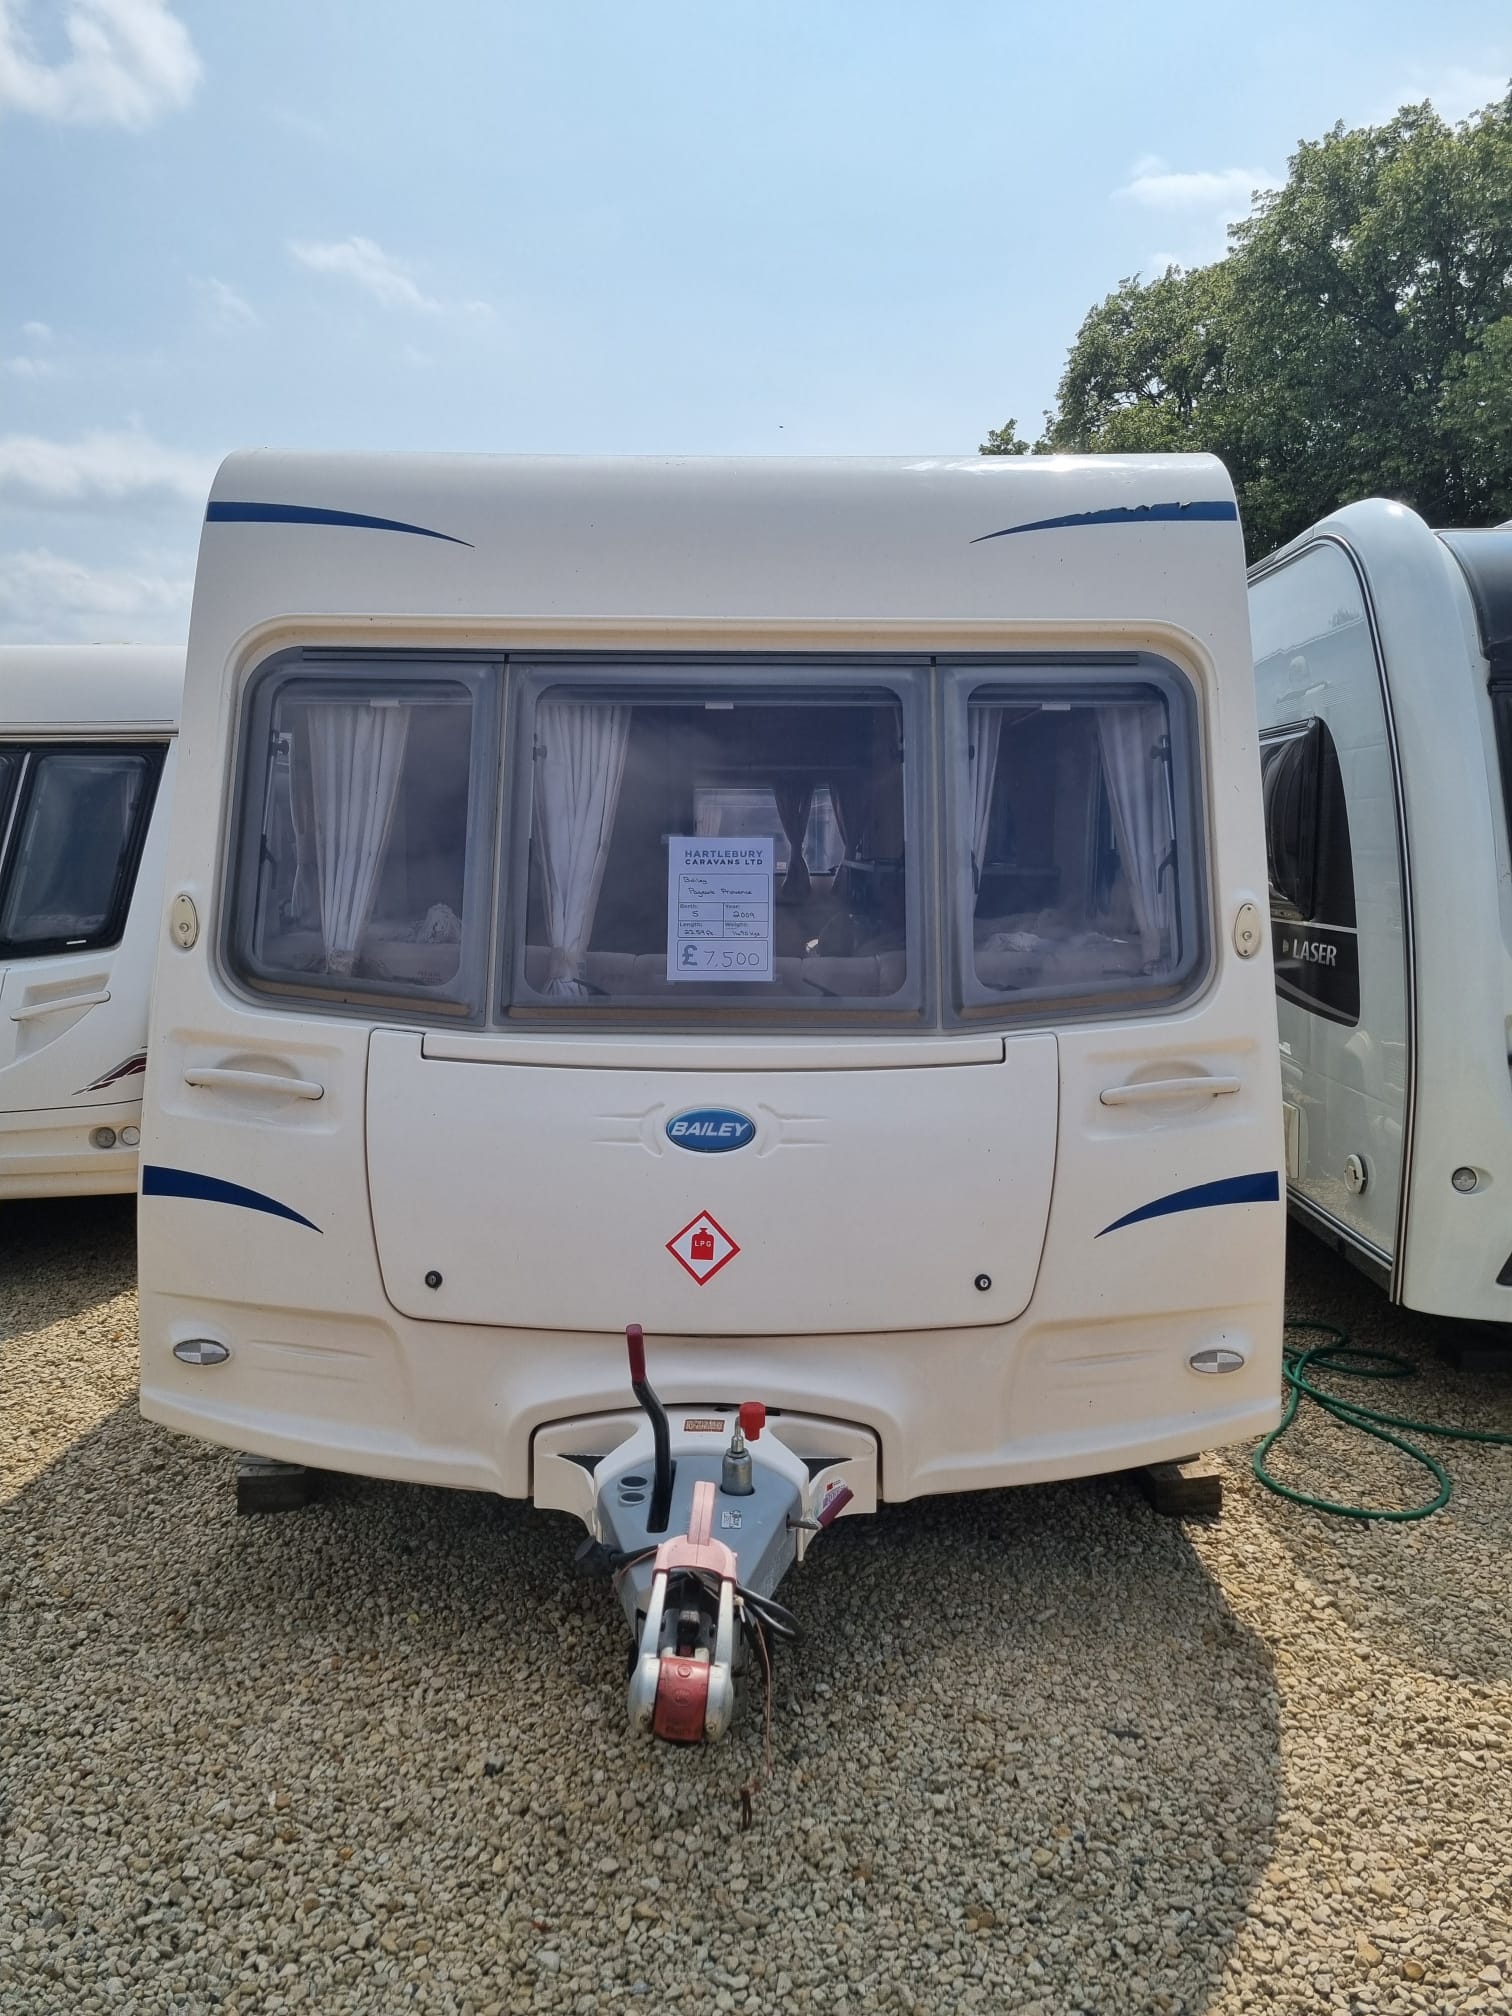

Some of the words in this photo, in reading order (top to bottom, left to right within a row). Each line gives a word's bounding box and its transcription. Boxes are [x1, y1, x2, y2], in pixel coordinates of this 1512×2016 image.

[684, 850, 763, 858] HARTLEBURY
[1292, 938, 1337, 967] LASER
[670, 1121, 749, 1137] BAILEY
